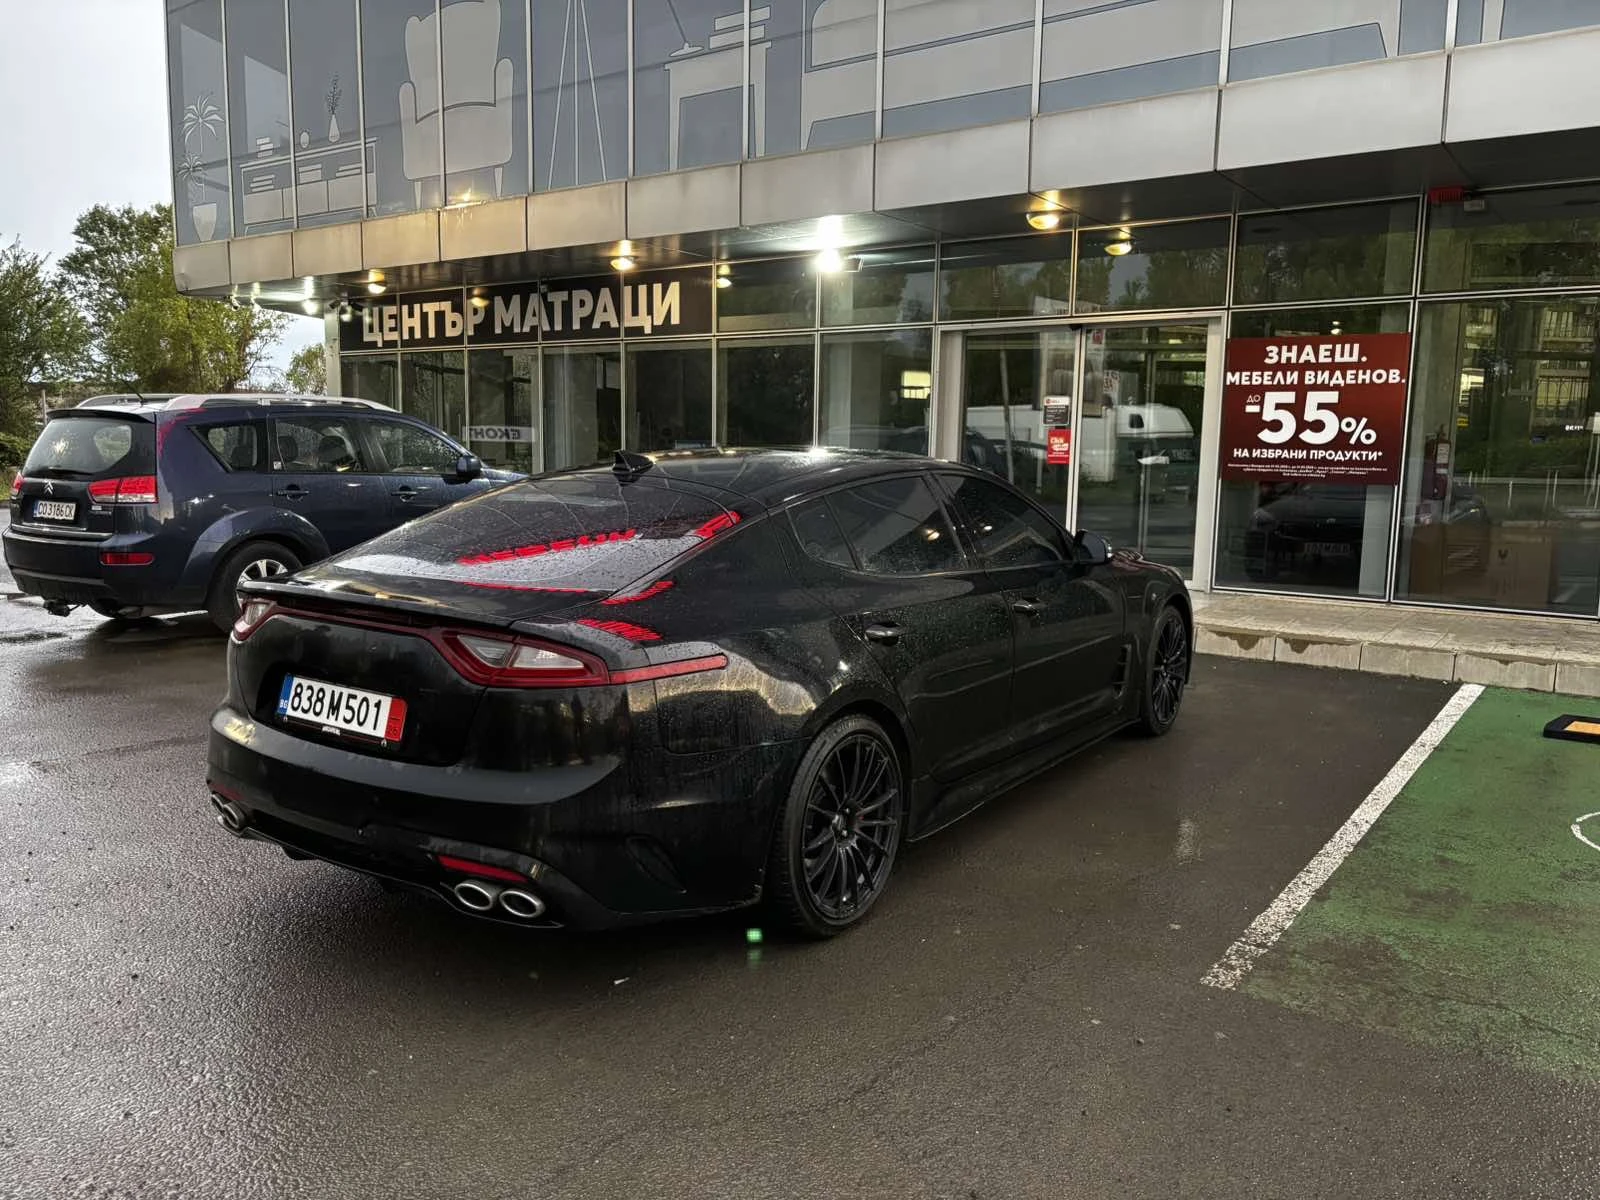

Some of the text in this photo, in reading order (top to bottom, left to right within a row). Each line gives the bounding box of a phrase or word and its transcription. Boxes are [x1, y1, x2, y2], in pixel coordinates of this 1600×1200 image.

[363, 281, 680, 347] ЦЕНТЪР МАТРАЦИ
[1264, 343, 1368, 365] ЗНАЕШ.
[1226, 368, 1406, 387] МЕБЕЛИ ВИДЕНОВ.
[1246, 394, 1261, 404] ДО
[1245, 391, 1377, 446] -55%
[1233, 448, 1249, 458] НА
[1252, 449, 1307, 460] ИЗБРАНИ
